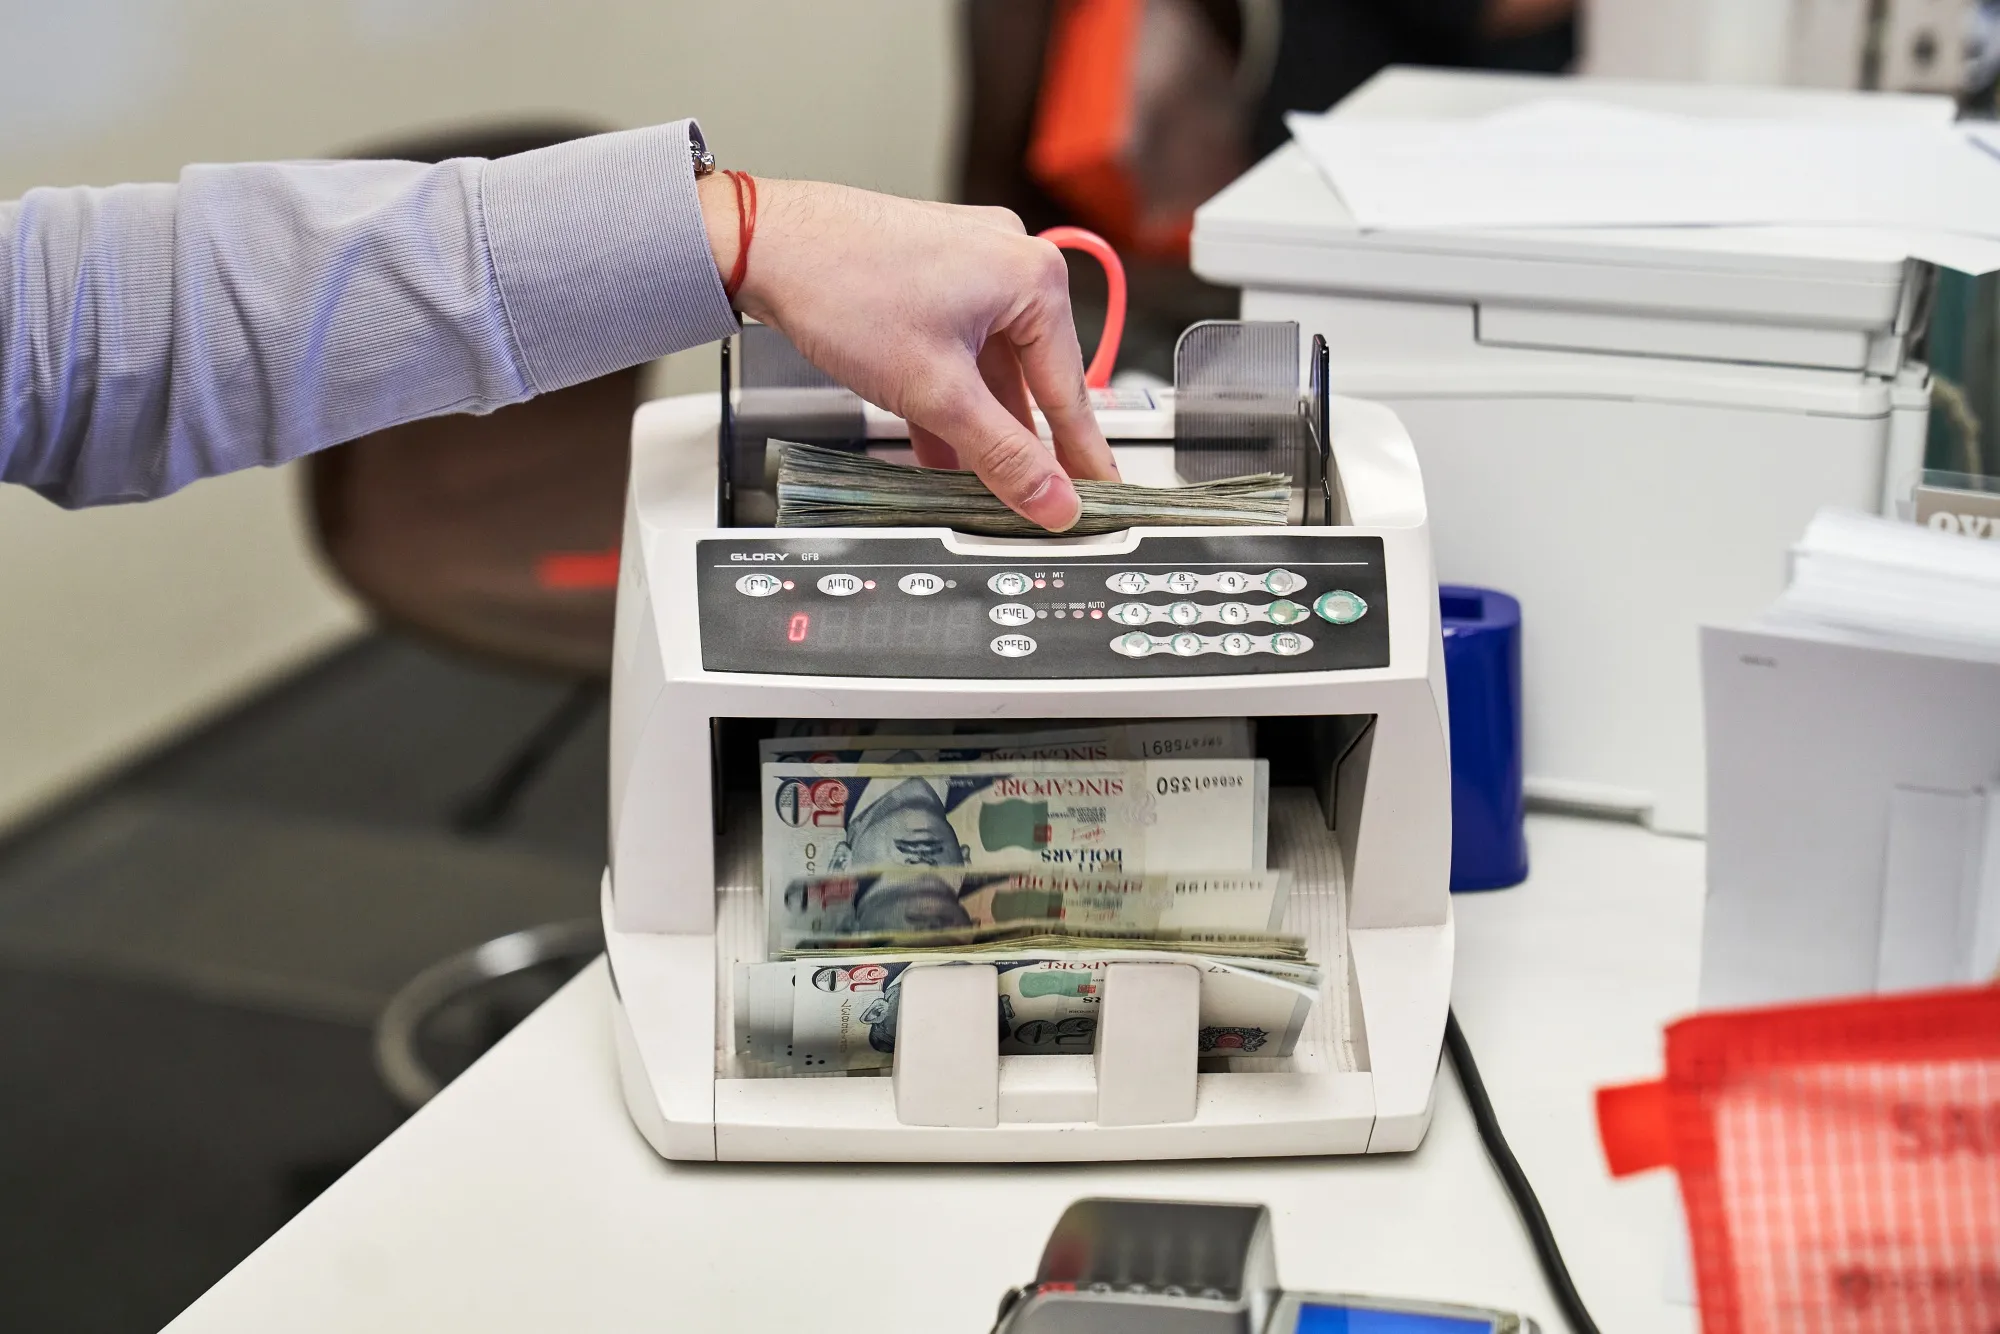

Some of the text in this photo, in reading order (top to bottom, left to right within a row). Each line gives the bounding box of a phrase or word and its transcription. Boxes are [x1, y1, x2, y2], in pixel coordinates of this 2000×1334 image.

[730, 553, 789, 561] GLORY
[1179, 573, 1185, 582] 8
[1228, 577, 1236, 587] 9
[827, 579, 854, 590] AUTO
[996, 608, 1029, 620] LEVEL
[1230, 607, 1238, 617] 6
[787, 613, 809, 642] 0
[997, 640, 1031, 652] SPEED
[1233, 638, 1241, 649] 3
[1277, 638, 1299, 649] ATCH
[992, 777, 1124, 797] SINGAPORE
[775, 778, 849, 828] 50
[1040, 848, 1123, 864] DOLLARS
[811, 964, 889, 993] 50
